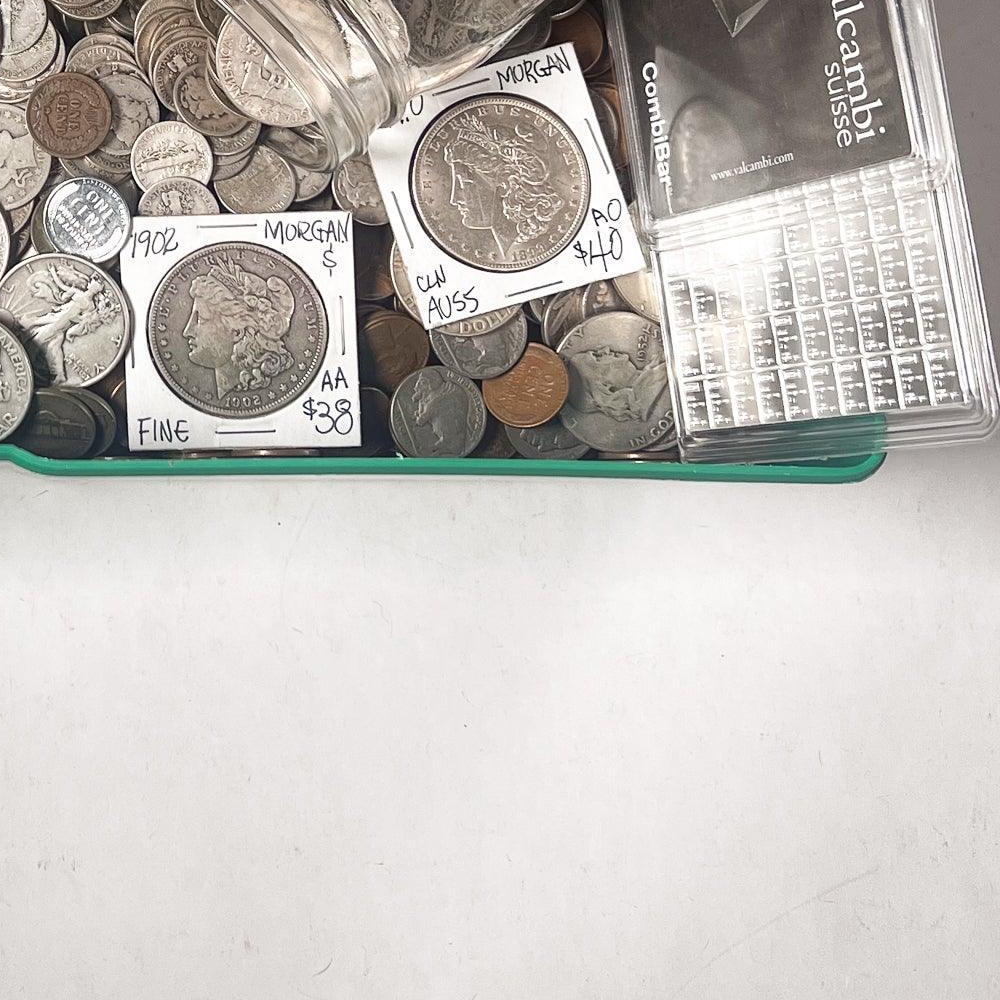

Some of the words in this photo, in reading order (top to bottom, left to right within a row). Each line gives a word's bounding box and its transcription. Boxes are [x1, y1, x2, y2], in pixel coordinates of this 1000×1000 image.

[496, 46, 573, 91] MORGAN
[56, 93, 70, 135] CENT
[68, 99, 81, 131] ONE
[642, 61, 672, 184] CombiBar
[825, 62, 853, 148] suisse
[709, 151, 795, 182] www.valcambi.com
[86, 190, 117, 224] ONE
[132, 227, 180, 259] 1902
[263, 213, 351, 245] MORGAN
[573, 226, 624, 273] $40
[289, 273, 317, 331] UNUM
[636, 334, 649, 362] 1952
[320, 366, 349, 392] AA
[225, 396, 261, 408] 1902
[302, 396, 354, 436] $38
[137, 416, 190, 446] FINE
[629, 435, 647, 448] IN
[650, 409, 674, 437] GOD
